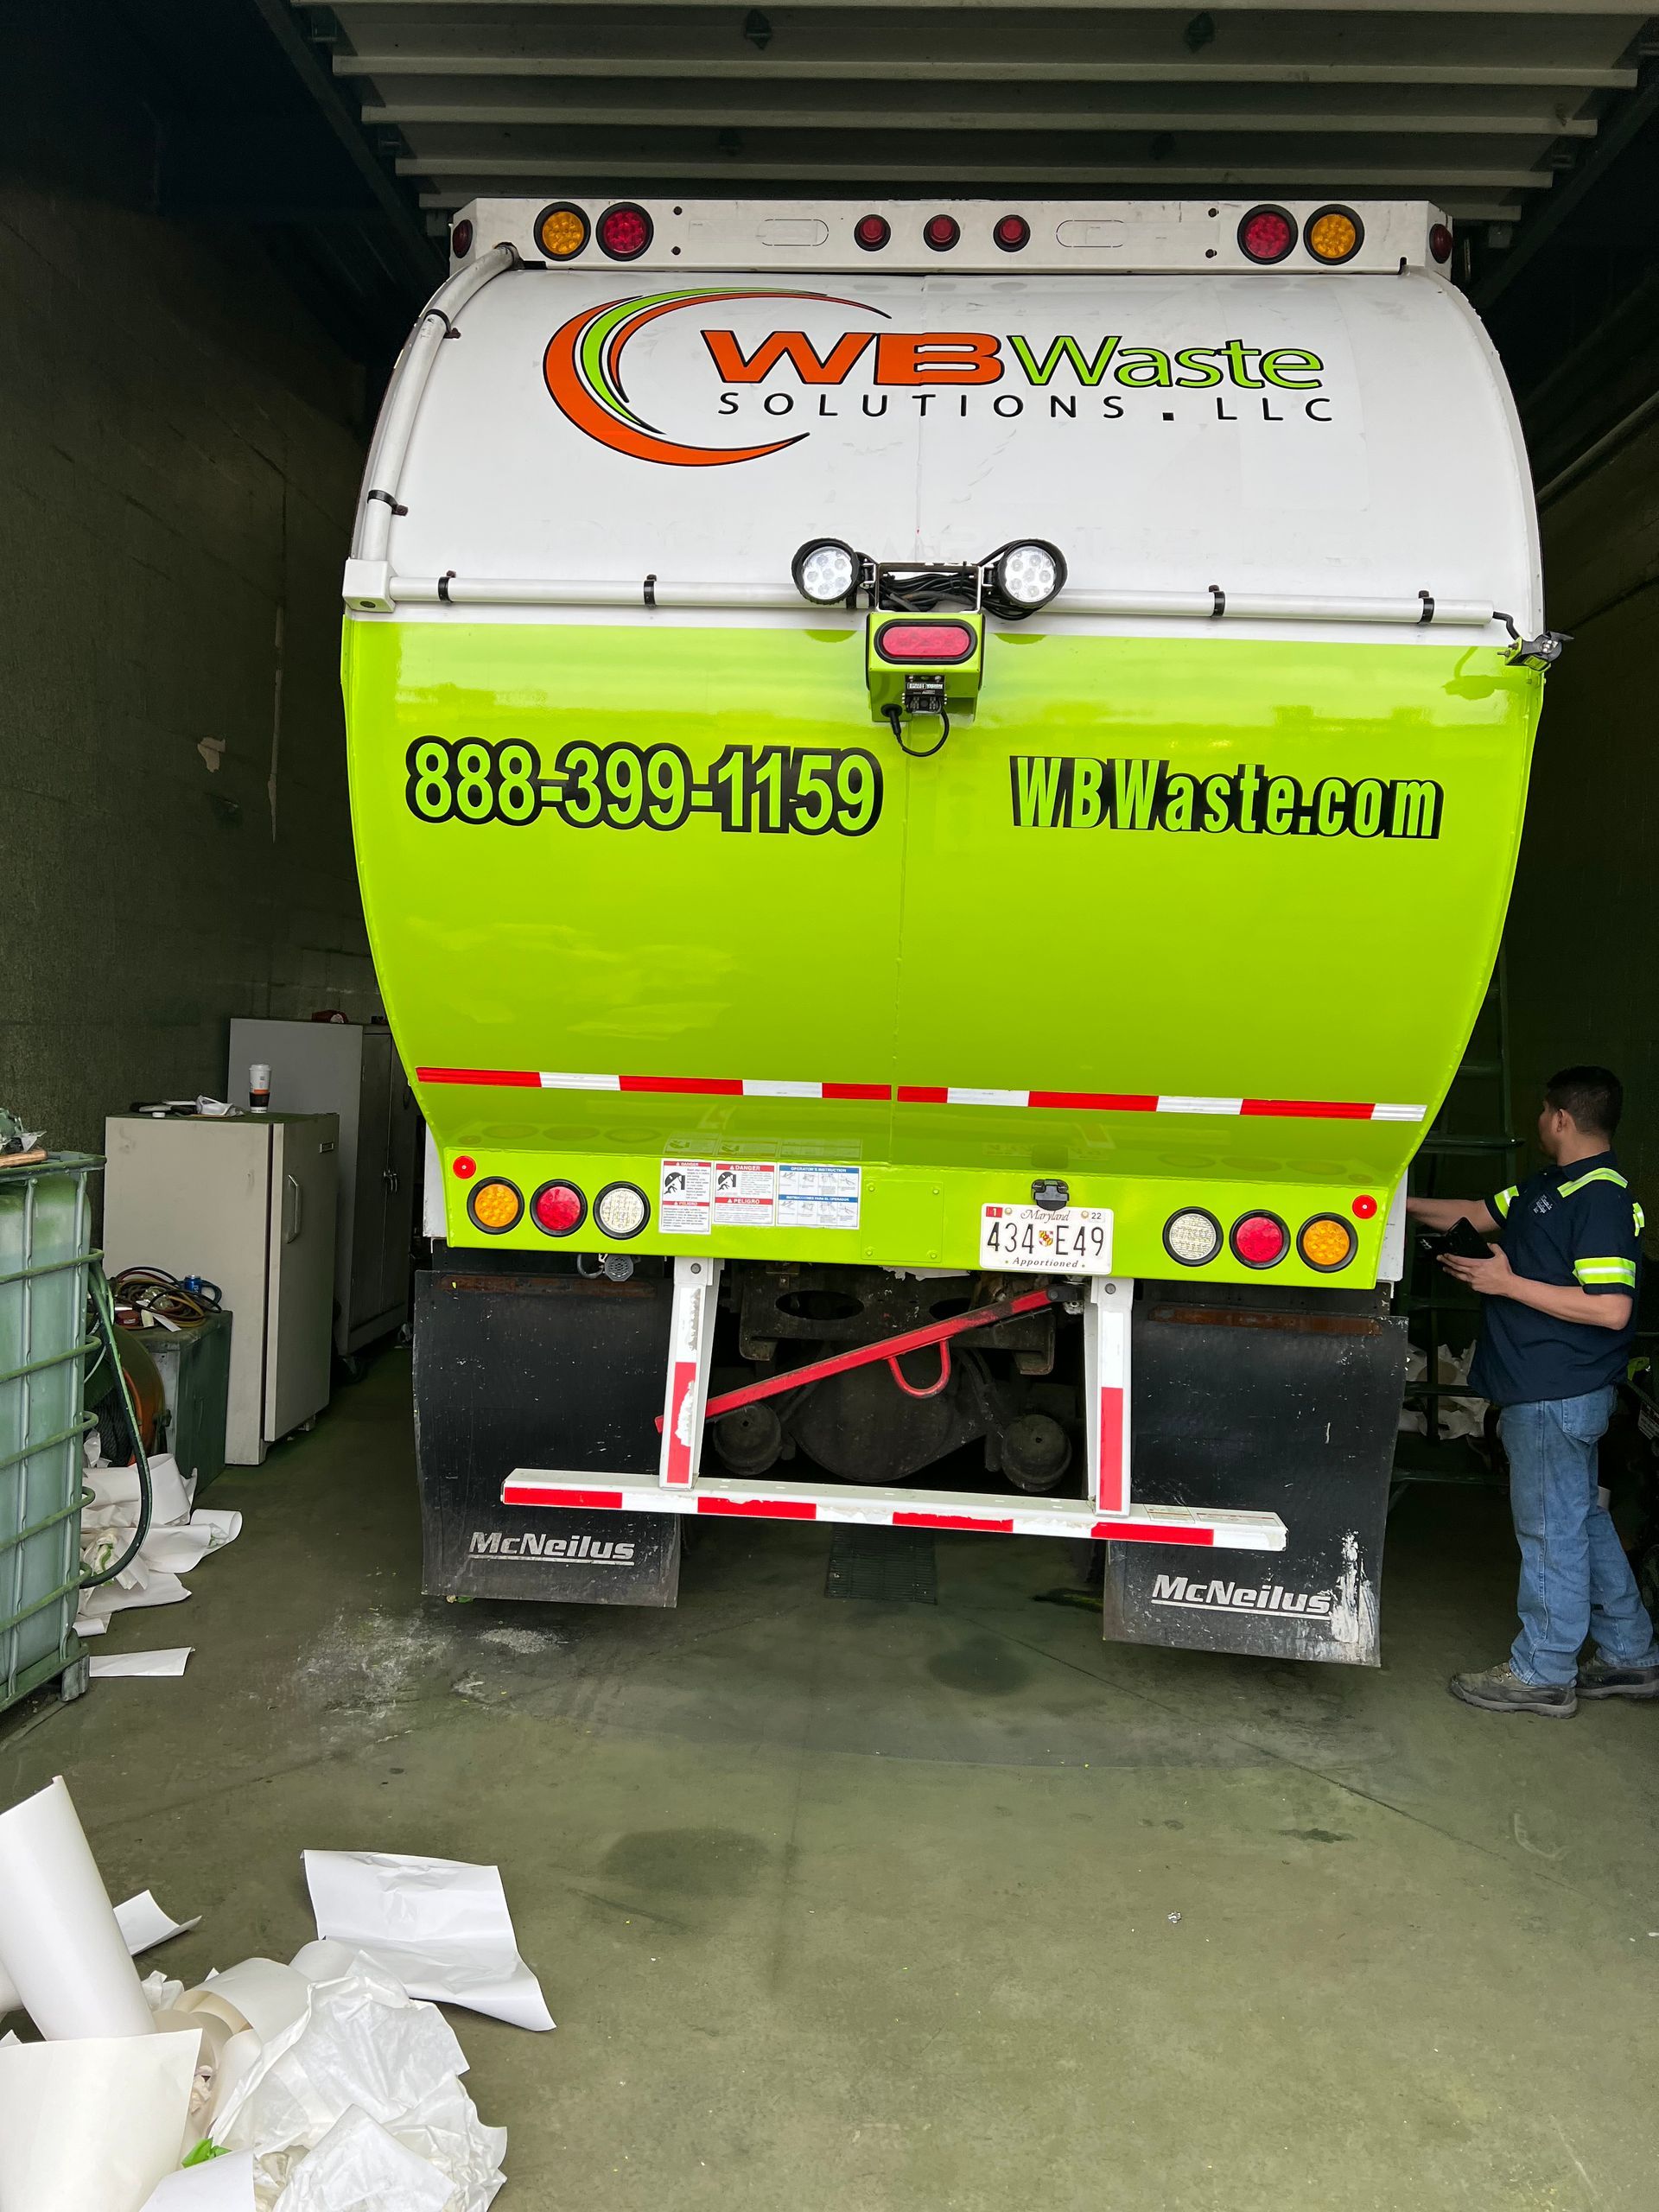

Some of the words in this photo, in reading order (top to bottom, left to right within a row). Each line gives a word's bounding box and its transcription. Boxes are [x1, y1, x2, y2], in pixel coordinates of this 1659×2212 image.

[1216, 396, 1333, 423] LLC
[405, 734, 884, 836] 888-399-1159
[1009, 754, 1445, 839] WBWaste.com
[1020, 1209, 1071, 1224] Maryland
[1090, 1211, 1102, 1220] 22
[987, 1221, 1034, 1254] 434
[1055, 1224, 1104, 1257] E49
[1012, 1256, 1078, 1268] Apportioned
[468, 1531, 635, 1560] McNeilus
[1152, 1573, 1332, 1614] McNeilus
